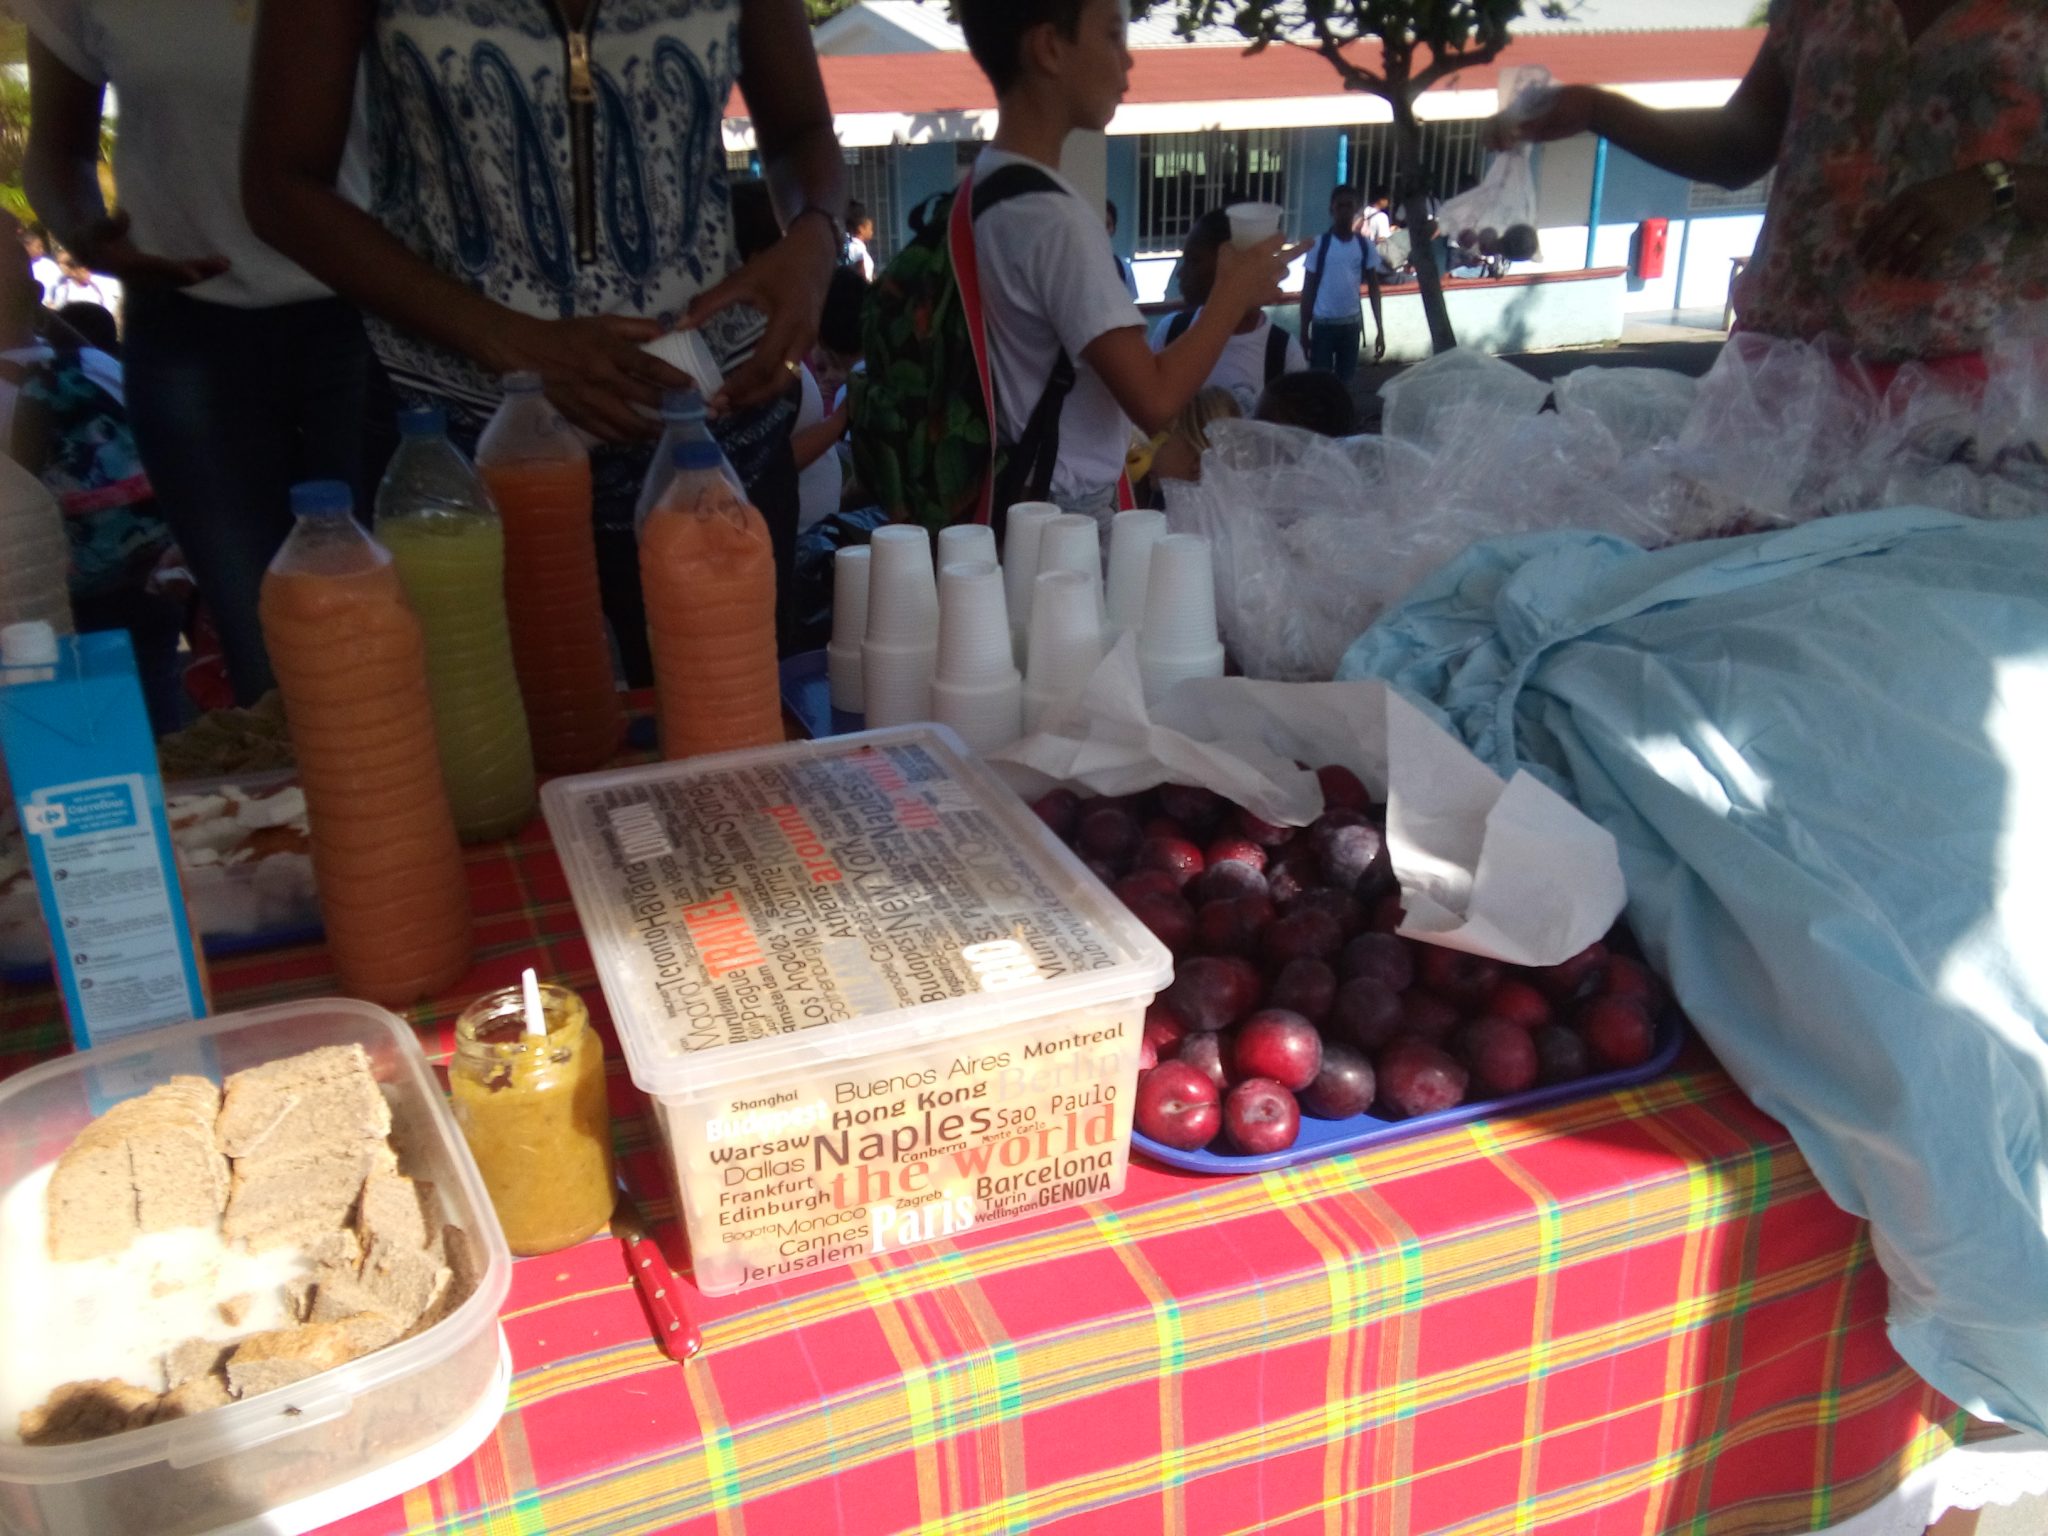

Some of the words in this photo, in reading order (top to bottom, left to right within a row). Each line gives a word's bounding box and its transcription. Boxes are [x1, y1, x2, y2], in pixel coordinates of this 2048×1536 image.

[607, 801, 674, 864] LONDON
[678, 779, 745, 836] Sydney
[830, 781, 914, 840] Naples
[758, 803, 845, 886] around
[825, 836, 888, 882] York
[615, 860, 672, 931] Havana
[692, 851, 745, 895] Tokyo
[738, 862, 784, 918] Salzburg
[751, 866, 825, 949] Melbourne
[799, 884, 858, 941] Athens
[856, 882, 924, 933] New
[676, 890, 771, 979] TRAVEL
[843, 910, 898, 963] Caracas
[757, 933, 817, 994] Angeles
[793, 946, 858, 1023] Gothenburg
[877, 931, 956, 1004] Budapest
[952, 936, 1051, 993] RIO
[667, 980, 724, 1052] Madrid
[704, 984, 749, 1045] Bordeaux
[721, 967, 773, 1021] Prague
[752, 964, 800, 1033] Amsterdam
[787, 995, 832, 1029] Los
[1024, 1022, 1123, 1060] Montreal
[731, 1089, 798, 1112] Shanghai
[835, 1069, 937, 1104] Buenos
[948, 1052, 1011, 1081] Aires
[1000, 1050, 1119, 1102] Berlin
[833, 1100, 906, 1131] Hong
[918, 1081, 988, 1111] Kong
[997, 1106, 1036, 1129] Sao
[1051, 1084, 1117, 1114] Paulo
[710, 1135, 809, 1165] Warsaw
[814, 1107, 991, 1172] Naples
[830, 1161, 930, 1210] the
[950, 1103, 1118, 1179] world
[901, 1141, 967, 1163] Canberra
[982, 1129, 1012, 1144] Monte
[1016, 1121, 1046, 1135] Carlo
[720, 1177, 814, 1207] Frankfurt
[724, 1158, 805, 1186] Dallas
[977, 1151, 1112, 1200] Barcelona
[1039, 1172, 1111, 1208] GENOVA
[719, 1190, 830, 1226] Edinburgh
[777, 1207, 866, 1238] Monaco
[871, 1188, 975, 1253] Paris
[896, 1190, 942, 1210] Zagreb
[975, 1201, 1038, 1223] Wellington
[983, 1192, 1026, 1211] Turin
[723, 1224, 777, 1243] Bogota
[779, 1225, 869, 1256] Cannes
[739, 1243, 864, 1286] Jerusalem
